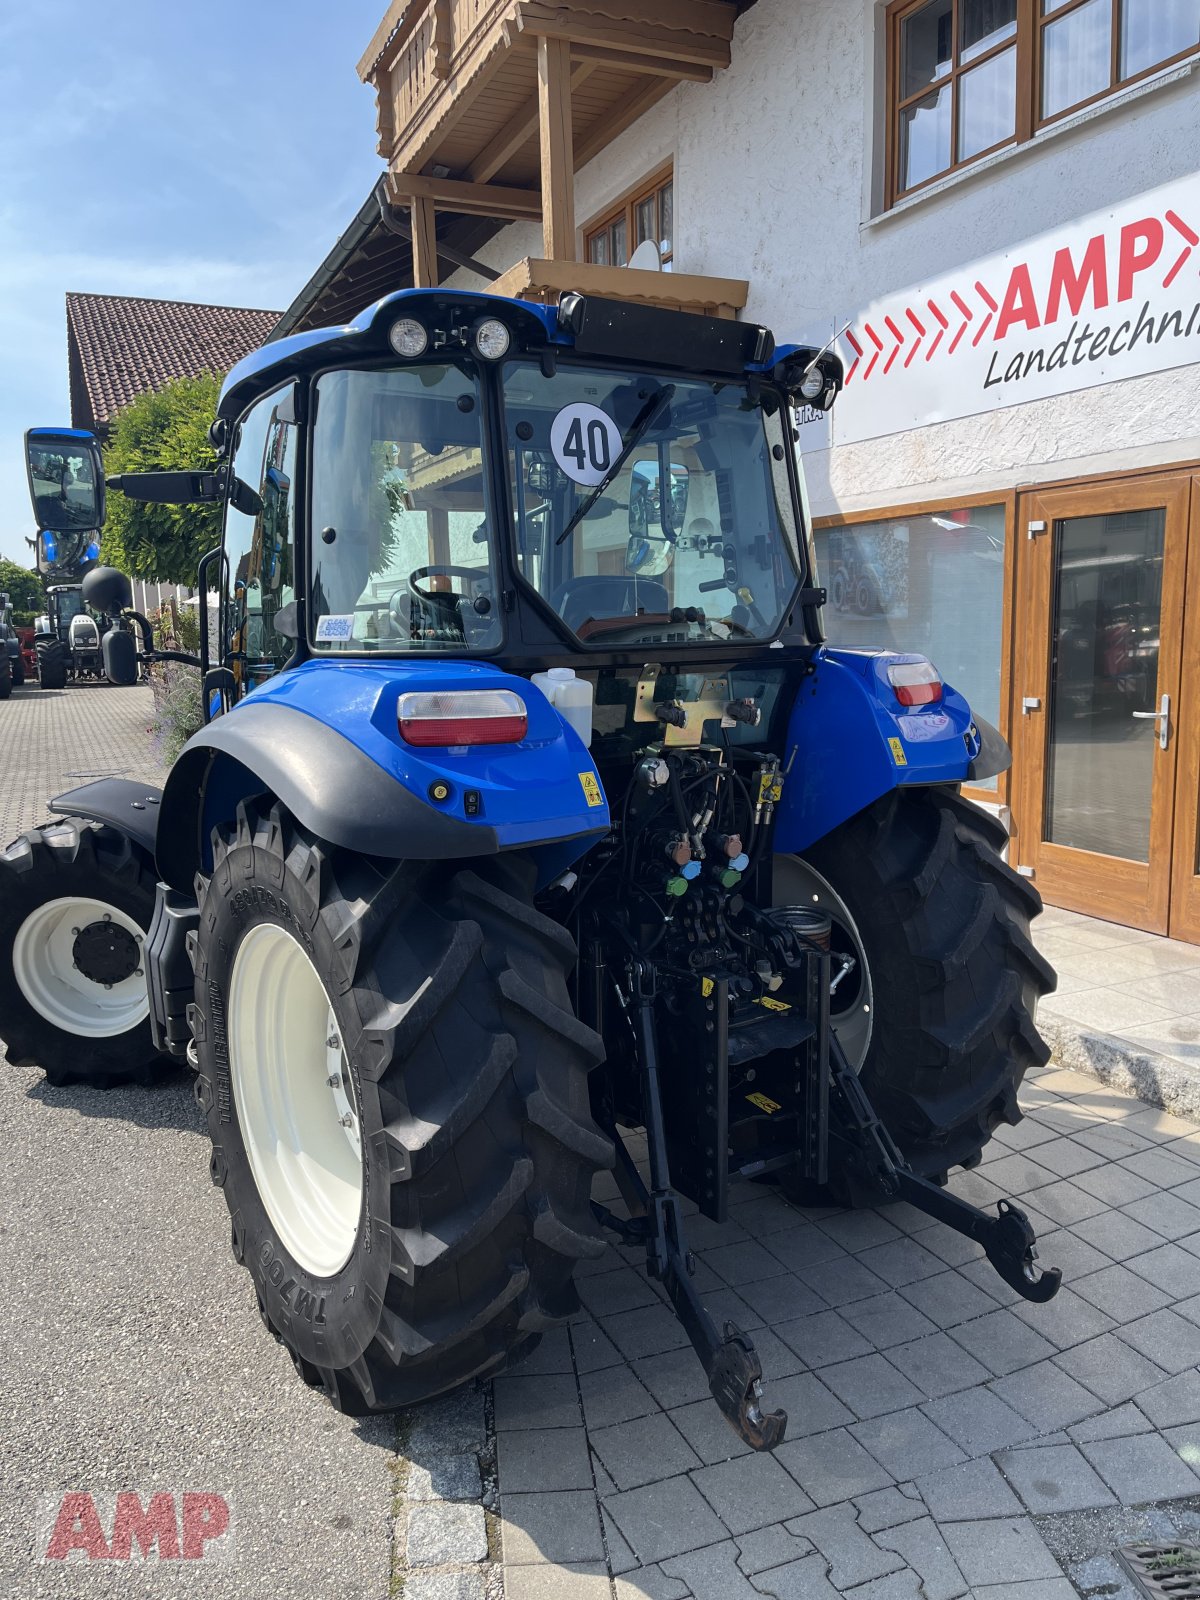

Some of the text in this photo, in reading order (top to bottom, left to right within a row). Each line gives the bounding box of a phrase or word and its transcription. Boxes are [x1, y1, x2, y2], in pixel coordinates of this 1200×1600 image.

[993, 217, 1164, 341] AMP
[983, 300, 1200, 389] Landtechni
[563, 417, 611, 472] 40
[795, 404, 824, 426] TRA
[260, 1239, 327, 1327] TM700
